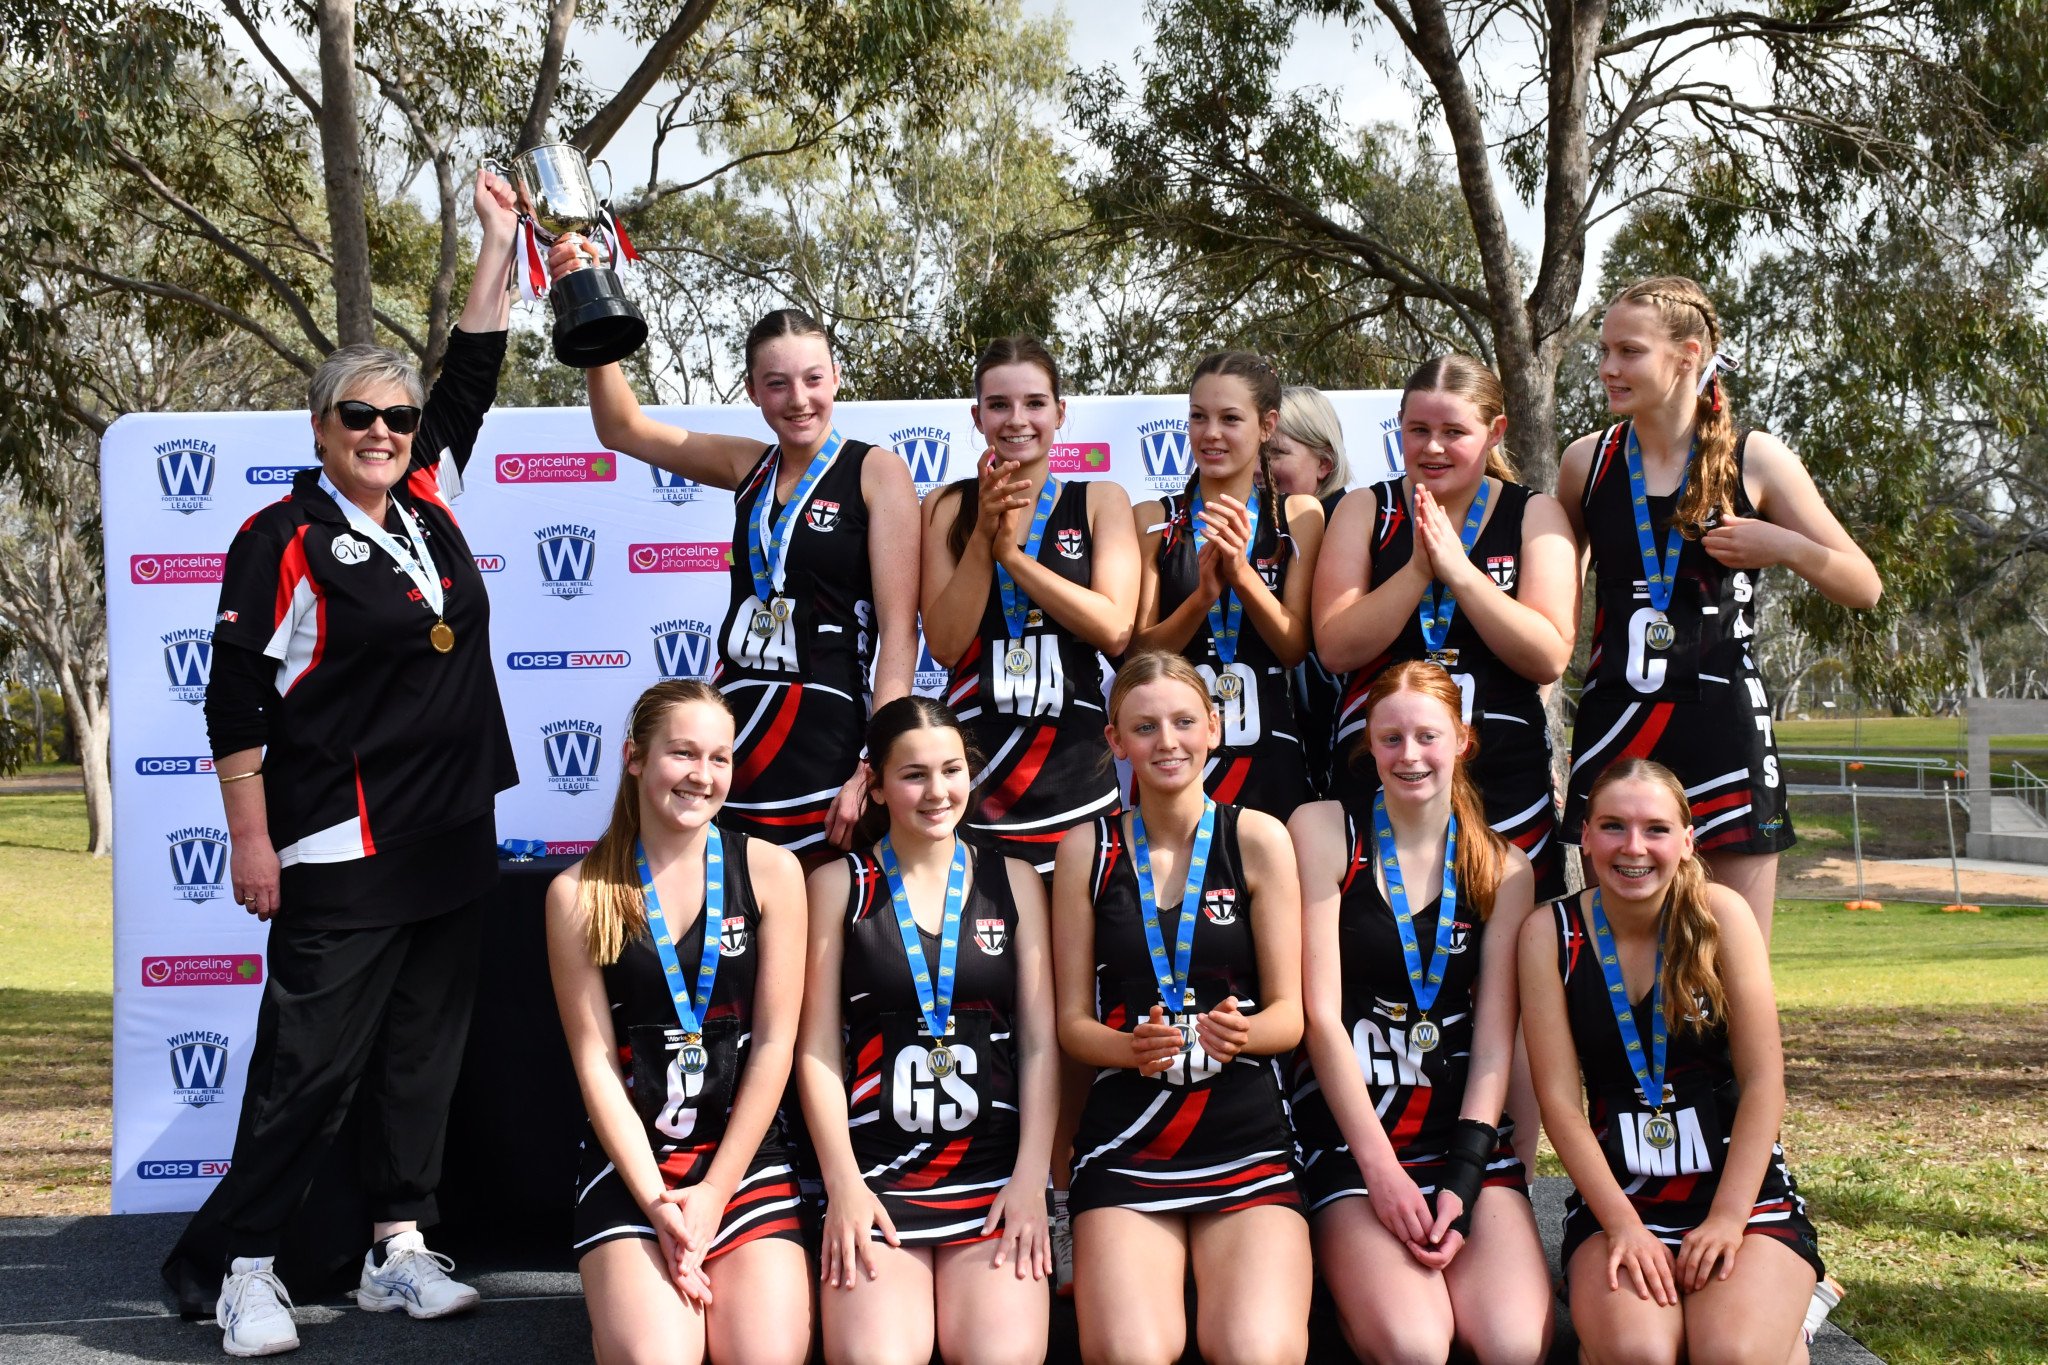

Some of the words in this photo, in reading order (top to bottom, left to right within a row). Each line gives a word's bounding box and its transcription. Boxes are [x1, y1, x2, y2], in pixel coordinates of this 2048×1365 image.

[889, 427, 951, 442] WIMMERA
[1137, 419, 1189, 436] WIMMER
[153, 438, 217, 456] WIMMERA
[1048, 447, 1080, 458] eline
[528, 456, 586, 470] priceline
[1048, 460, 1080, 471] macy
[160, 452, 212, 495] W
[529, 467, 587, 480] pharmacy
[534, 524, 596, 541] WIMMERA
[541, 538, 591, 580] W
[661, 545, 719, 559] priceline
[164, 556, 222, 570] priceline
[661, 558, 720, 570] pharmacy
[164, 567, 223, 581] pharmacy
[650, 619, 712, 636] WIMMERA
[728, 595, 800, 673] GA
[161, 629, 213, 645] WIMMER
[659, 633, 707, 676] W
[1625, 607, 1669, 693] C
[513, 654, 562, 667] 1089
[571, 654, 624, 665] 3WM
[993, 634, 1064, 718] WA
[179, 692, 205, 700] LEAGU
[540, 720, 602, 736] WIMMERA
[549, 733, 597, 776] W
[142, 760, 191, 773] 1089
[166, 826, 228, 844] WIMMERA
[173, 840, 224, 884] W
[174, 957, 232, 972] priceline
[174, 970, 233, 982] pharmacy
[166, 1031, 229, 1048] WIMMERA
[685, 1051, 699, 1064] W
[1353, 1018, 1432, 1087] GK
[174, 1044, 224, 1088] W
[893, 1044, 979, 1134] GS
[1618, 1107, 1713, 1176] WA
[144, 1163, 193, 1176] 1089
[202, 1163, 231, 1174] 3W
